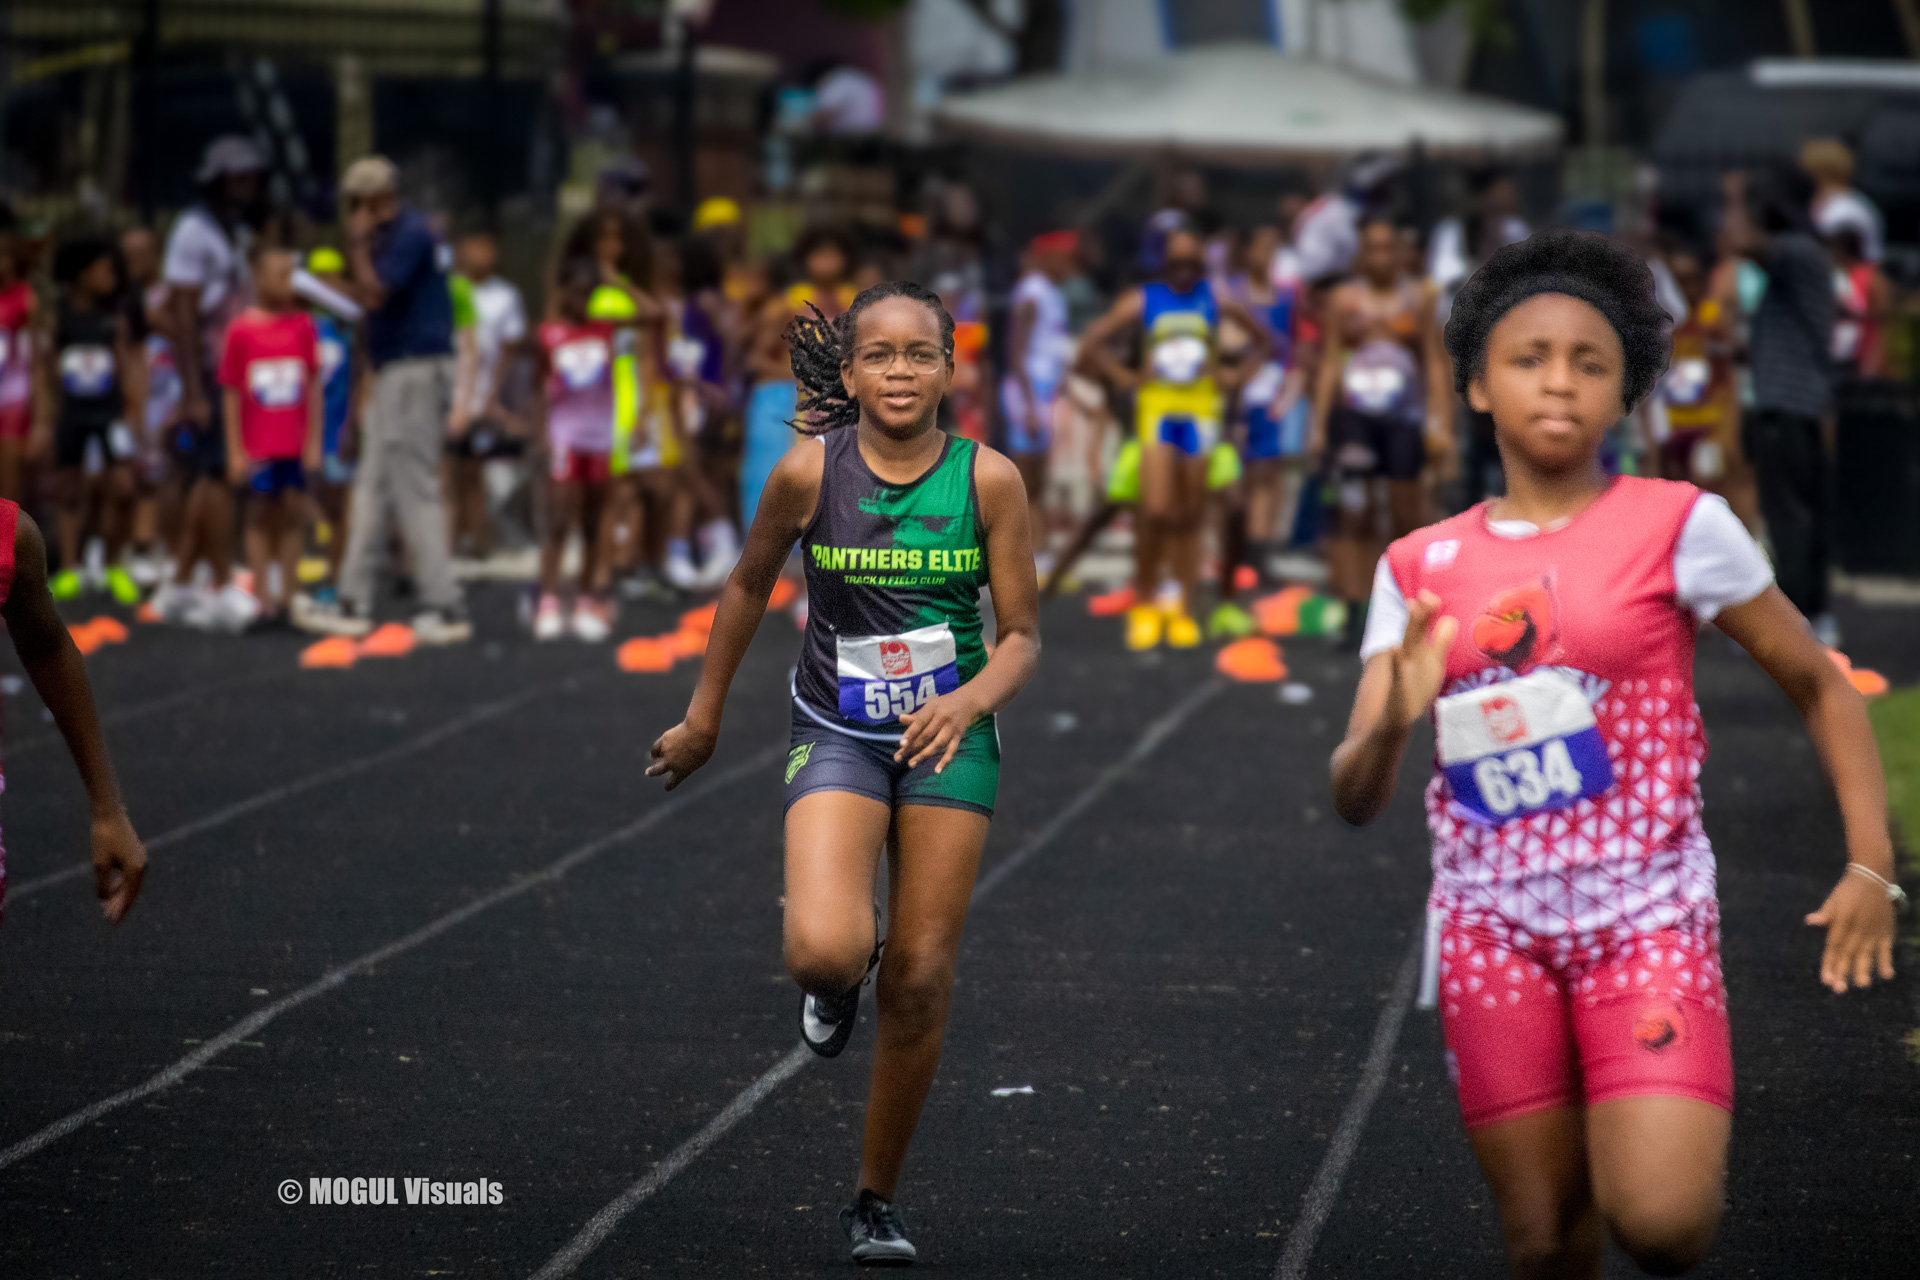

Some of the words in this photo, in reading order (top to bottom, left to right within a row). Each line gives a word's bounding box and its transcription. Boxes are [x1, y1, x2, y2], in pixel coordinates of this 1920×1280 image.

[812, 544, 923, 571] PANTHERS
[929, 547, 980, 572] ELITE
[844, 575, 877, 585] TRACK
[888, 576, 918, 585] FIELD
[919, 576, 946, 586] CLUB
[864, 674, 939, 720] 554
[1473, 738, 1583, 816] 634
